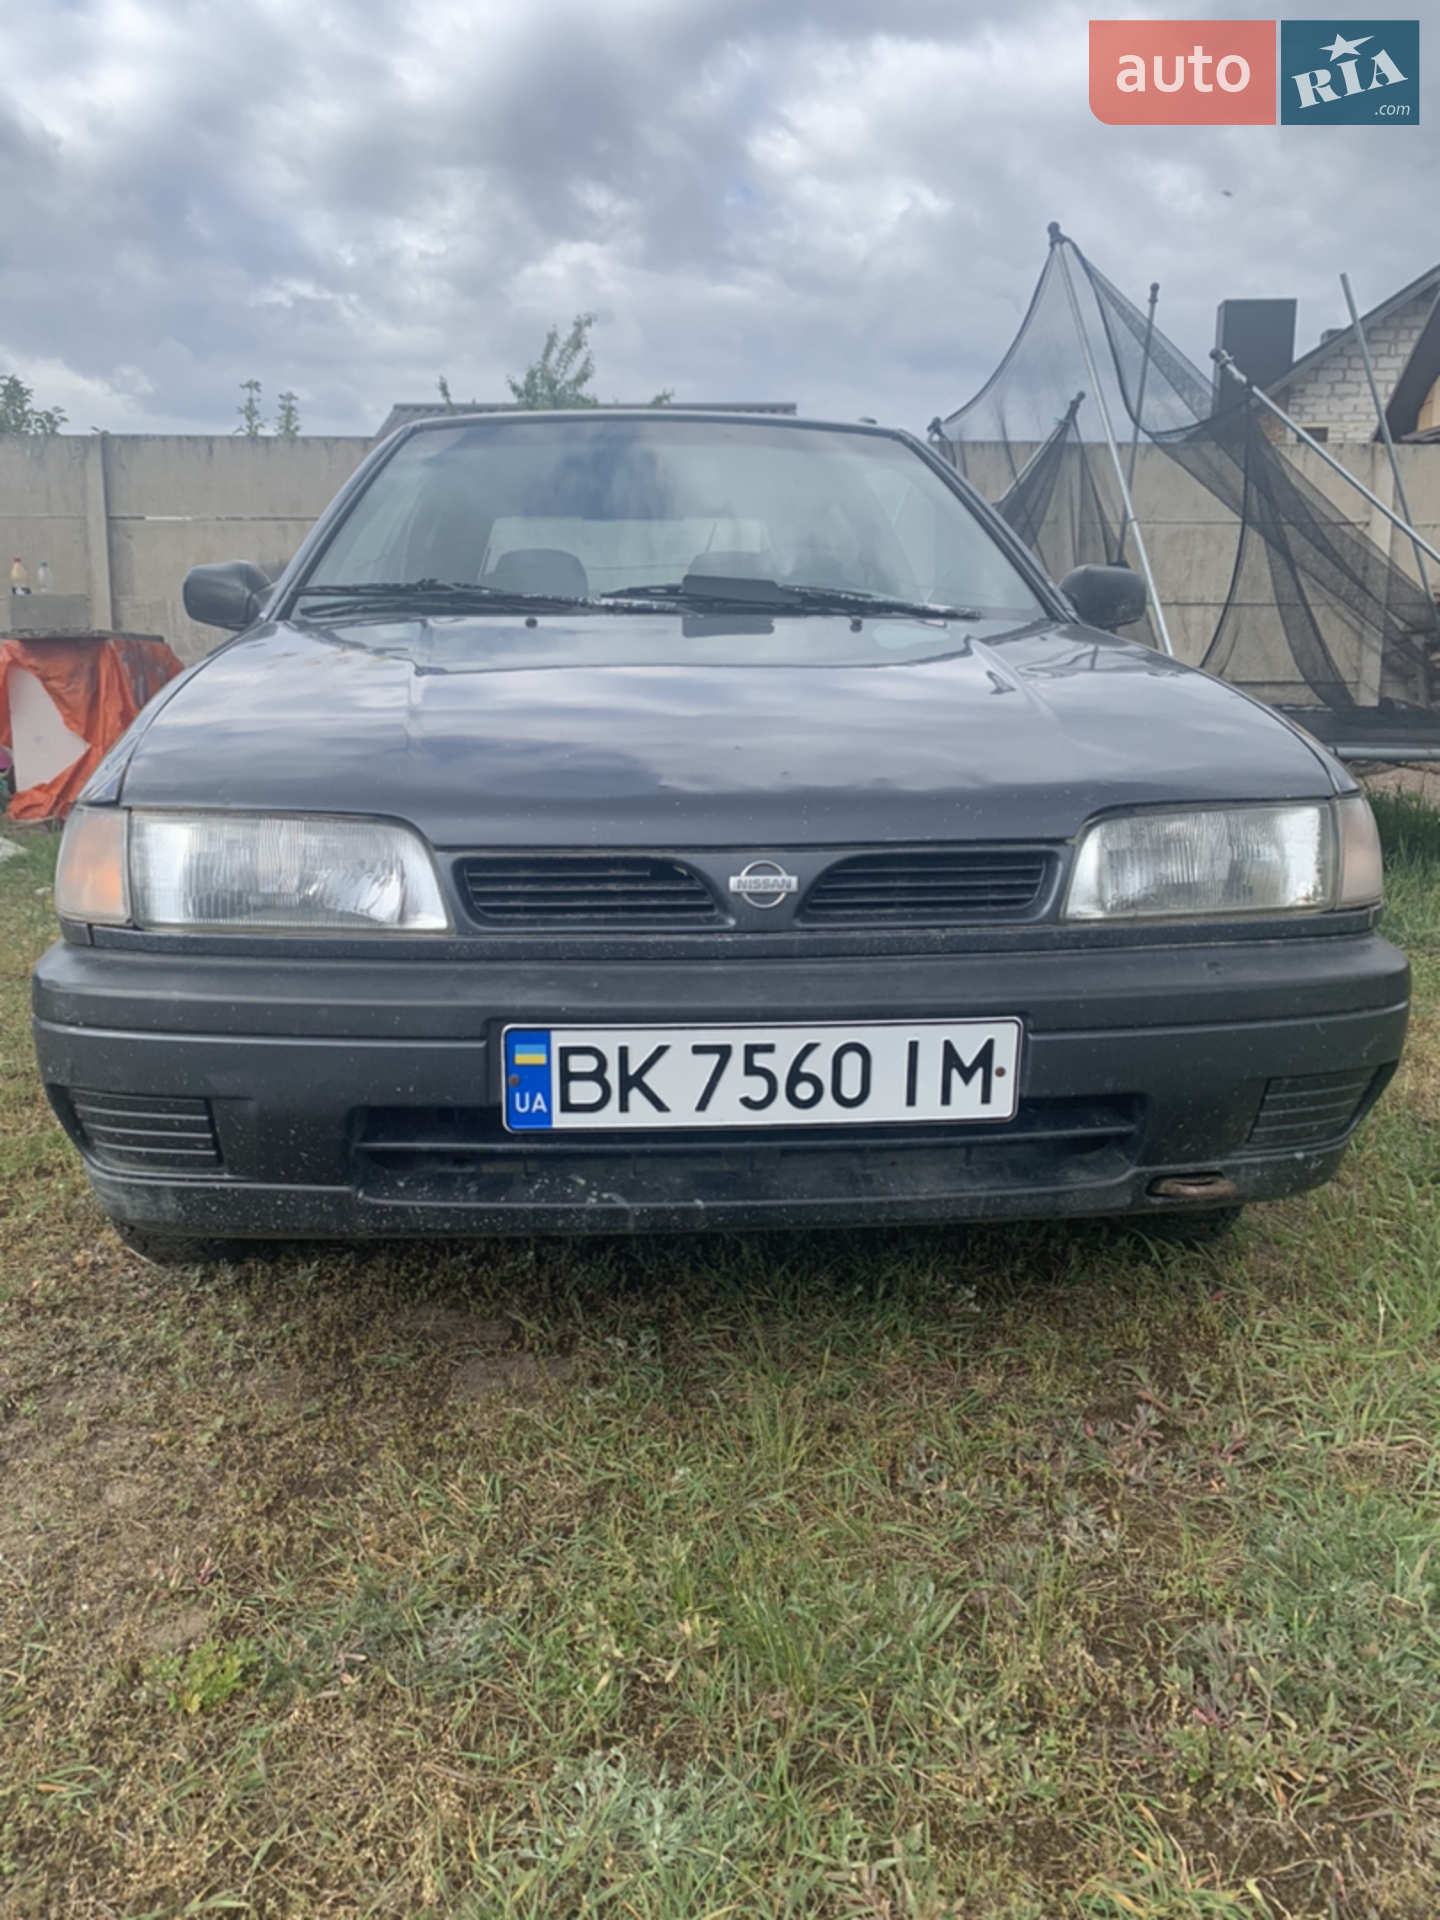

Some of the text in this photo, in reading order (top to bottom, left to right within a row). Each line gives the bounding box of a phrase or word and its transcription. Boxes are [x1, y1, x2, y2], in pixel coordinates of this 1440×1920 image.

[737, 878, 792, 890] NISSAN
[558, 1038, 995, 1114] BK 7560 IM
[515, 1092, 547, 1114] UA
